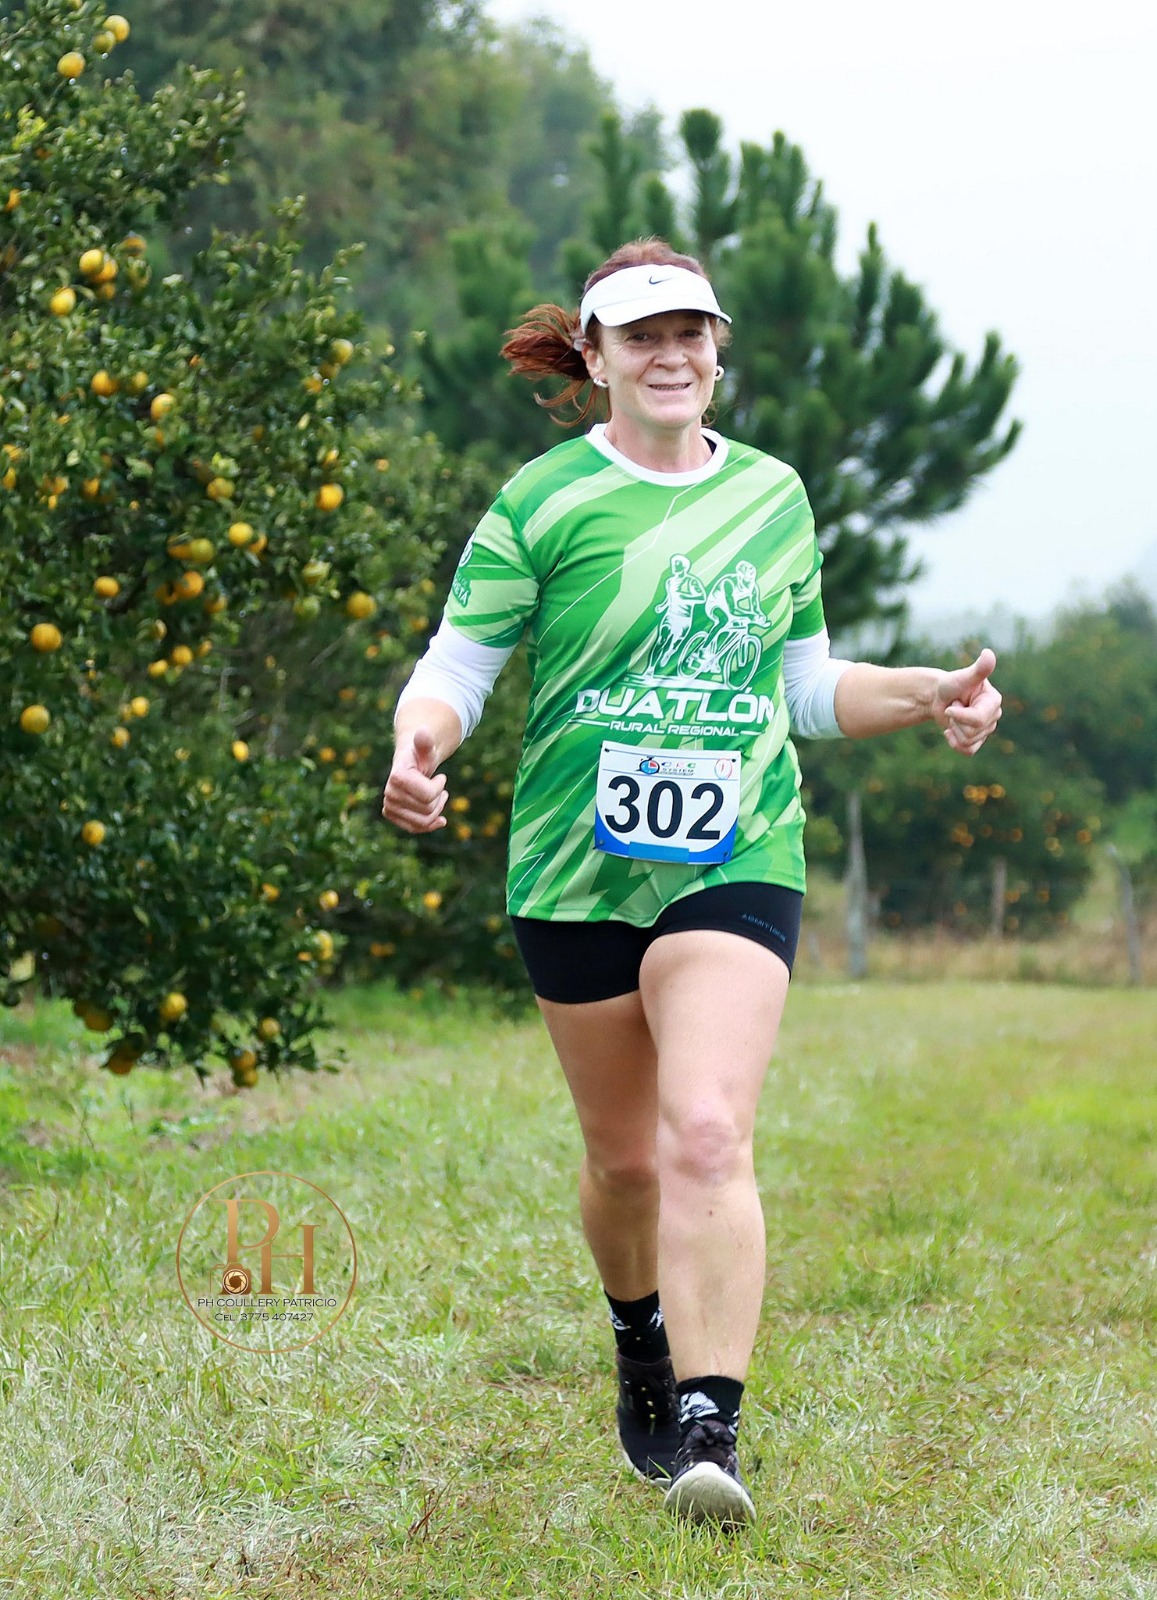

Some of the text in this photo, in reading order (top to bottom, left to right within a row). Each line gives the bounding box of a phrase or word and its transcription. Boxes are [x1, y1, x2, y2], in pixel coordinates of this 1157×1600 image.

[575, 686, 775, 724] DUATLÓN
[610, 720, 740, 737] RURAL REGIONAL
[605, 775, 724, 840] 302
